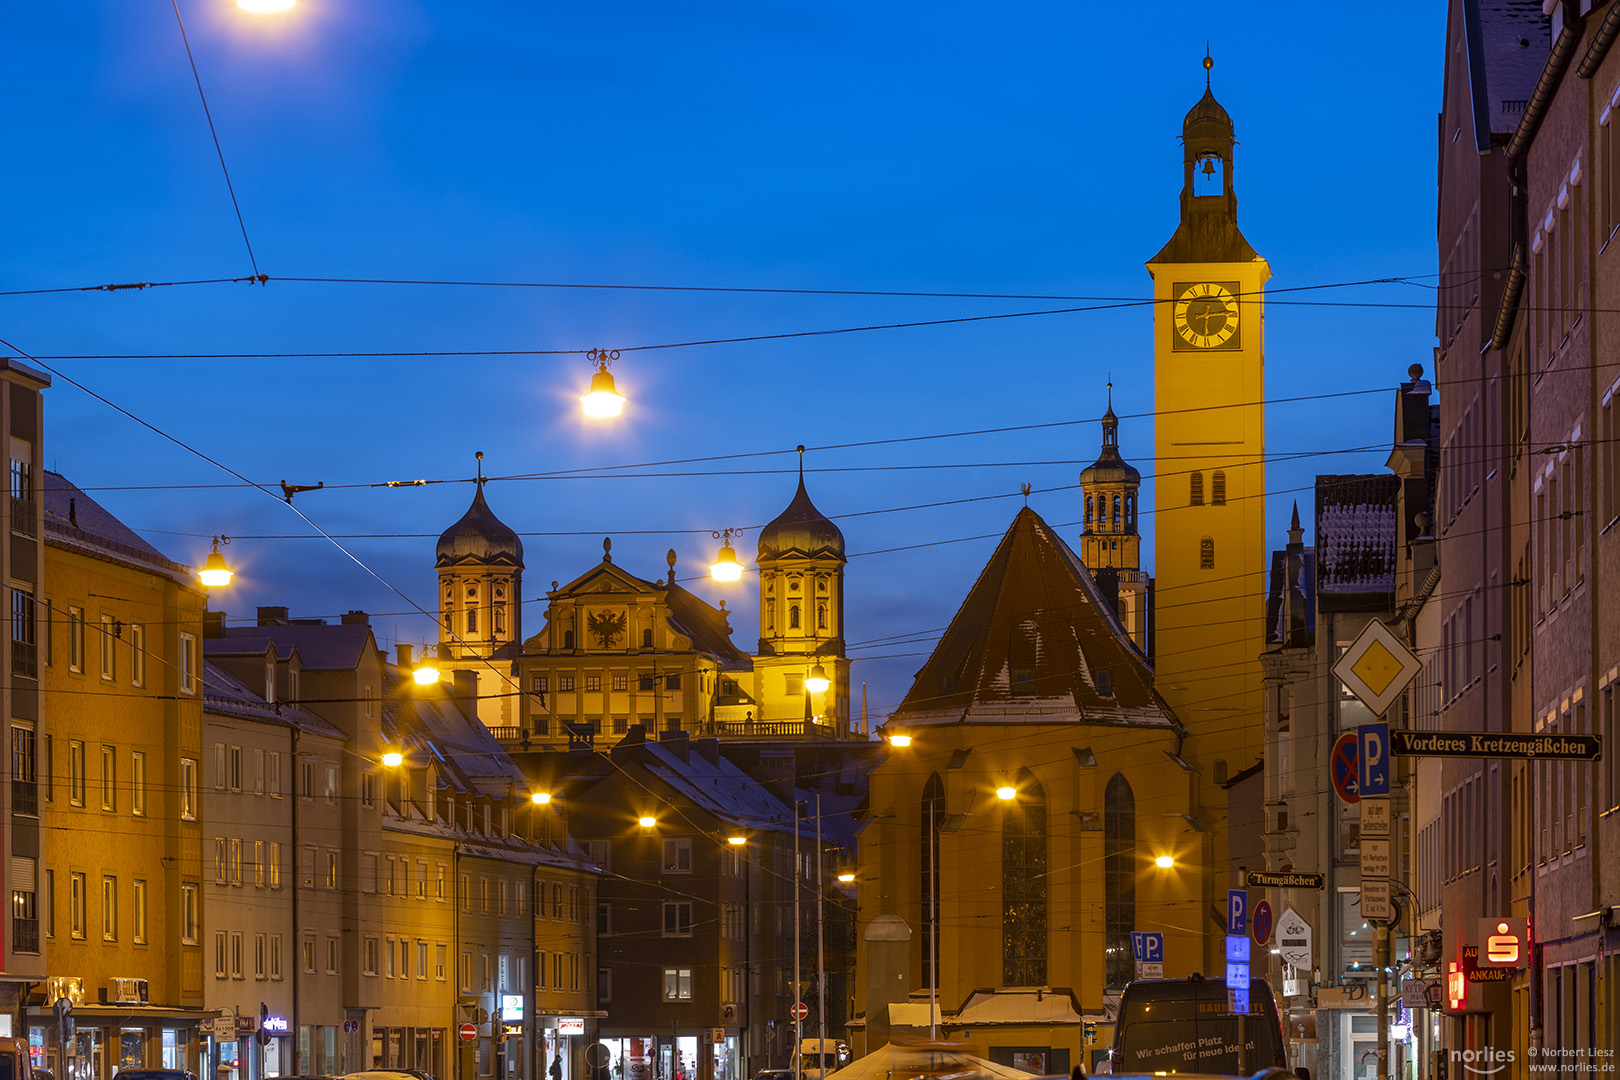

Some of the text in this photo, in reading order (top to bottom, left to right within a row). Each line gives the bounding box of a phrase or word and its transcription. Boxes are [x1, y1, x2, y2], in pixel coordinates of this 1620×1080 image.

[1403, 733, 1587, 757] Vorderes Kretzengäßchen
[1364, 732, 1383, 787] P
[1255, 873, 1315, 887] Turmgäßchen
[1231, 895, 1243, 930] P
[1146, 936, 1159, 959] P
[1464, 947, 1478, 958] AU
[1136, 1036, 1223, 1059] Wir schaffen Platz
[1182, 1040, 1255, 1061] für neue Iden!
